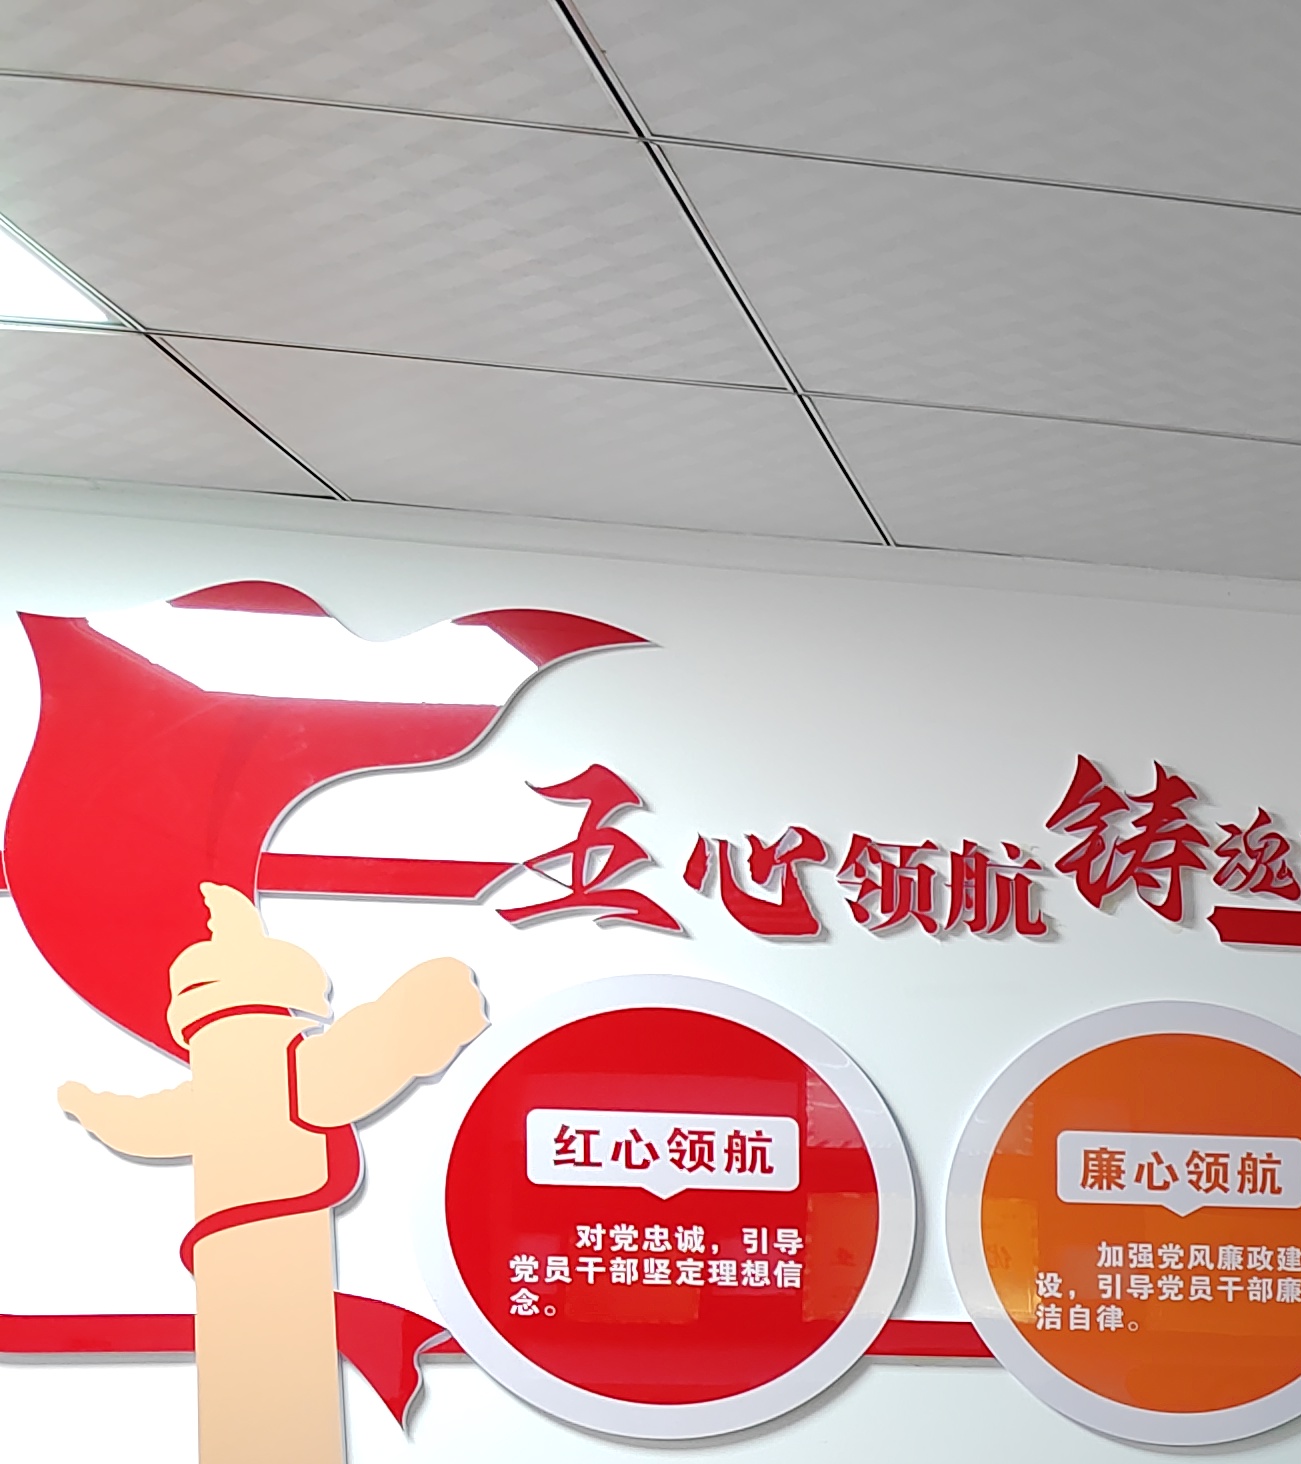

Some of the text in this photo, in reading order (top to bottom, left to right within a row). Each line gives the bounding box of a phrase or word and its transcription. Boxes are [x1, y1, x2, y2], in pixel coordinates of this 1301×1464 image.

[553, 1124, 774, 1174] 红心领航
[1080, 1147, 1282, 1195] 廉心领航
[576, 1223, 804, 1255] 对党忠诚，引导
[509, 1254, 803, 1289] 党员干部坚定理想信
[509, 1288, 557, 1317] 念。
[1036, 1304, 1139, 1332] 洁自律。
